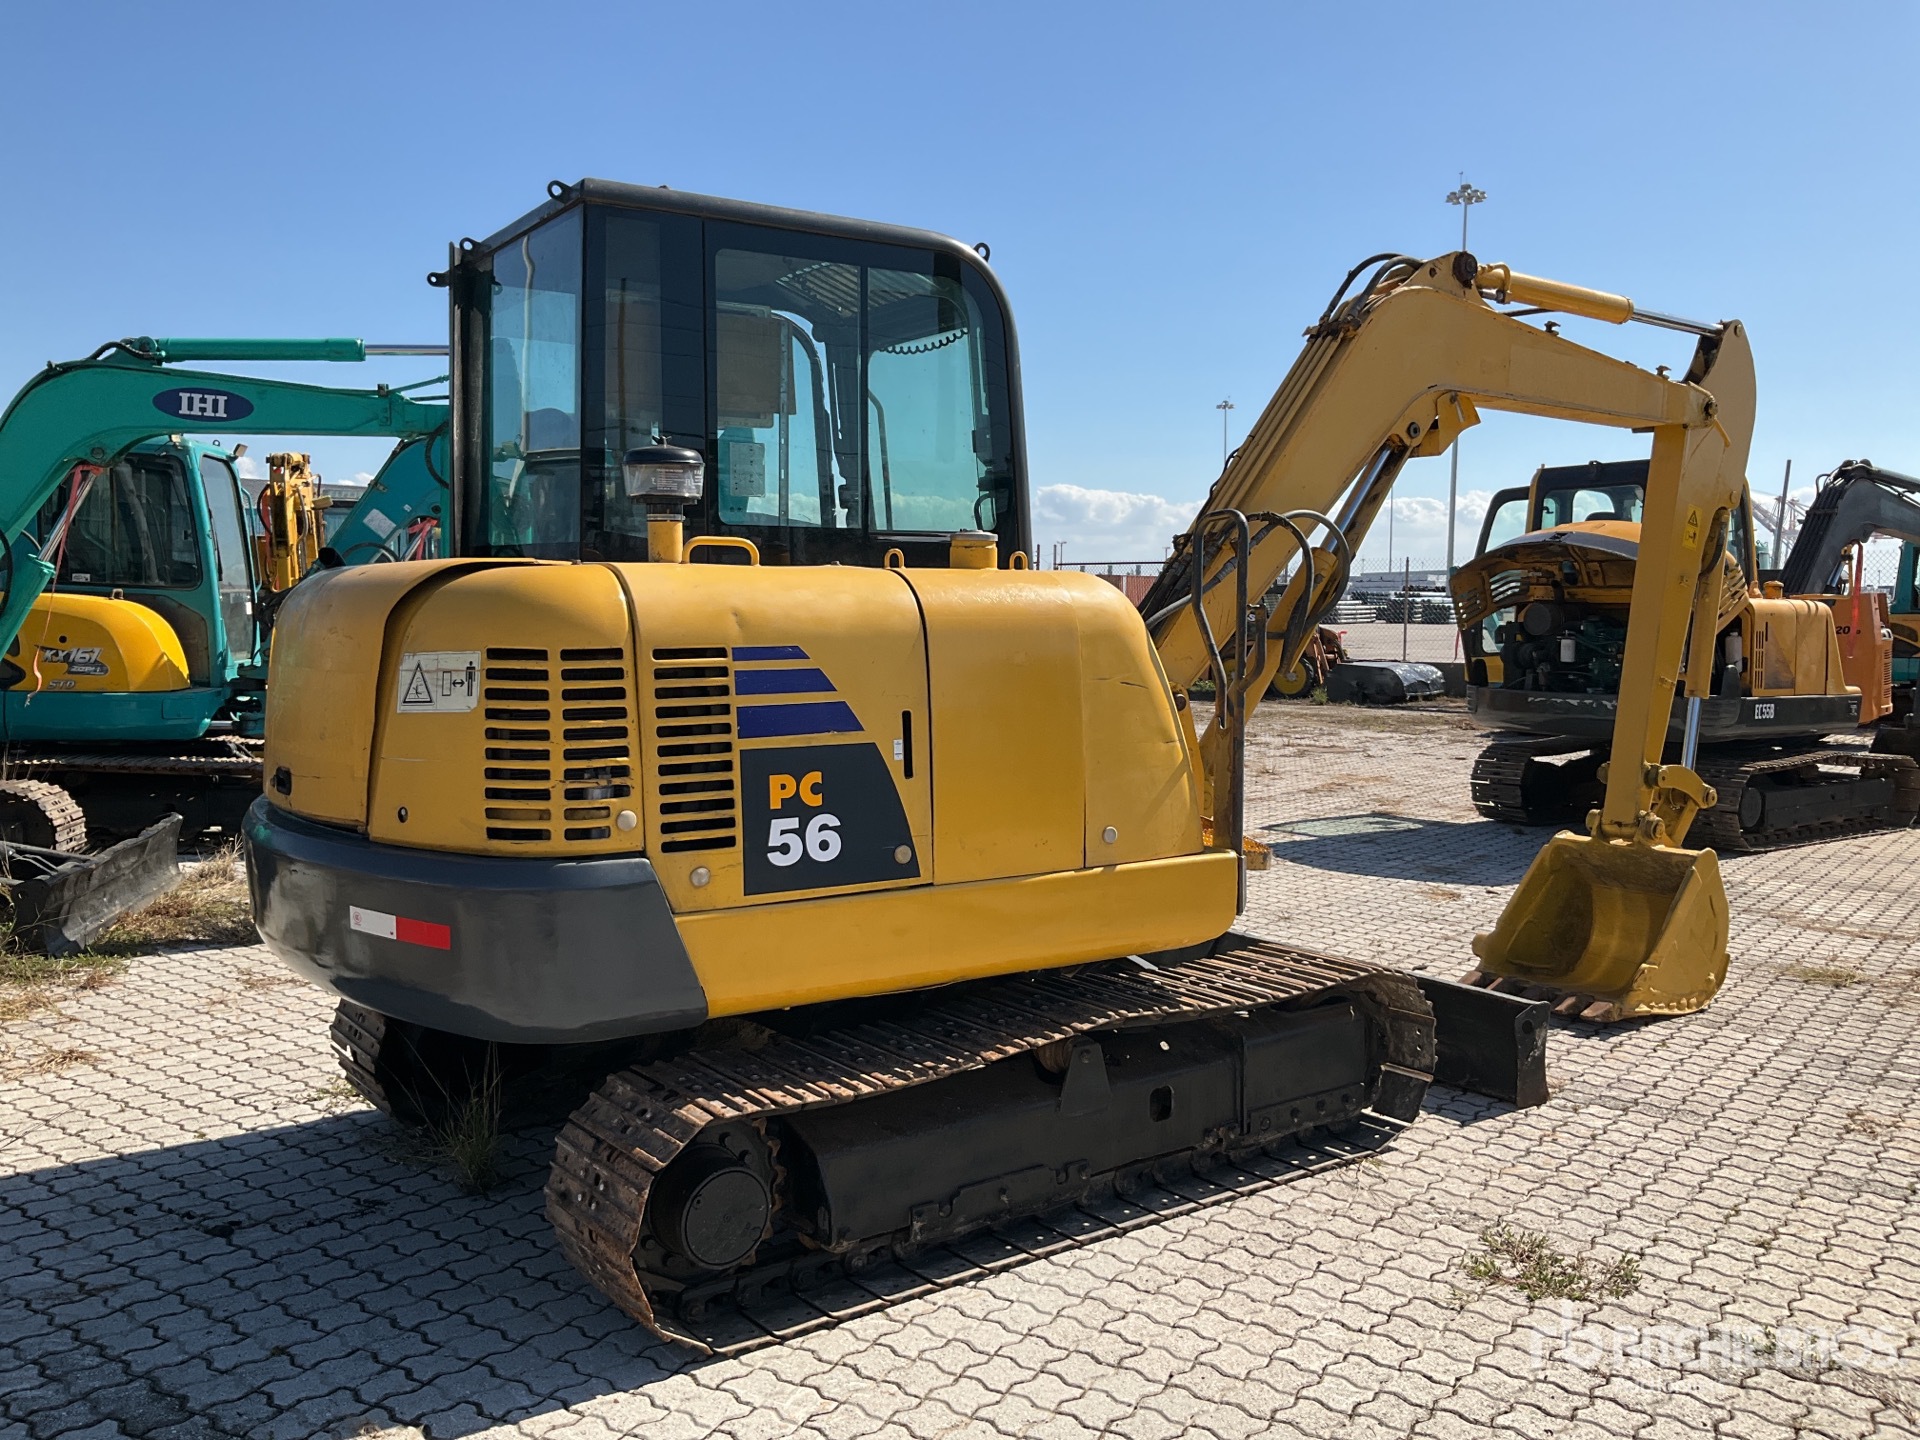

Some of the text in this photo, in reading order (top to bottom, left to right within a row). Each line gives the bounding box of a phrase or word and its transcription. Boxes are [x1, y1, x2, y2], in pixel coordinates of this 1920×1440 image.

[179, 392, 228, 418] IHI
[43, 647, 103, 664] KX161
[47, 679, 76, 690] STD
[1754, 703, 1775, 719] EC55B
[769, 771, 823, 810] PC
[767, 813, 842, 867] 56
